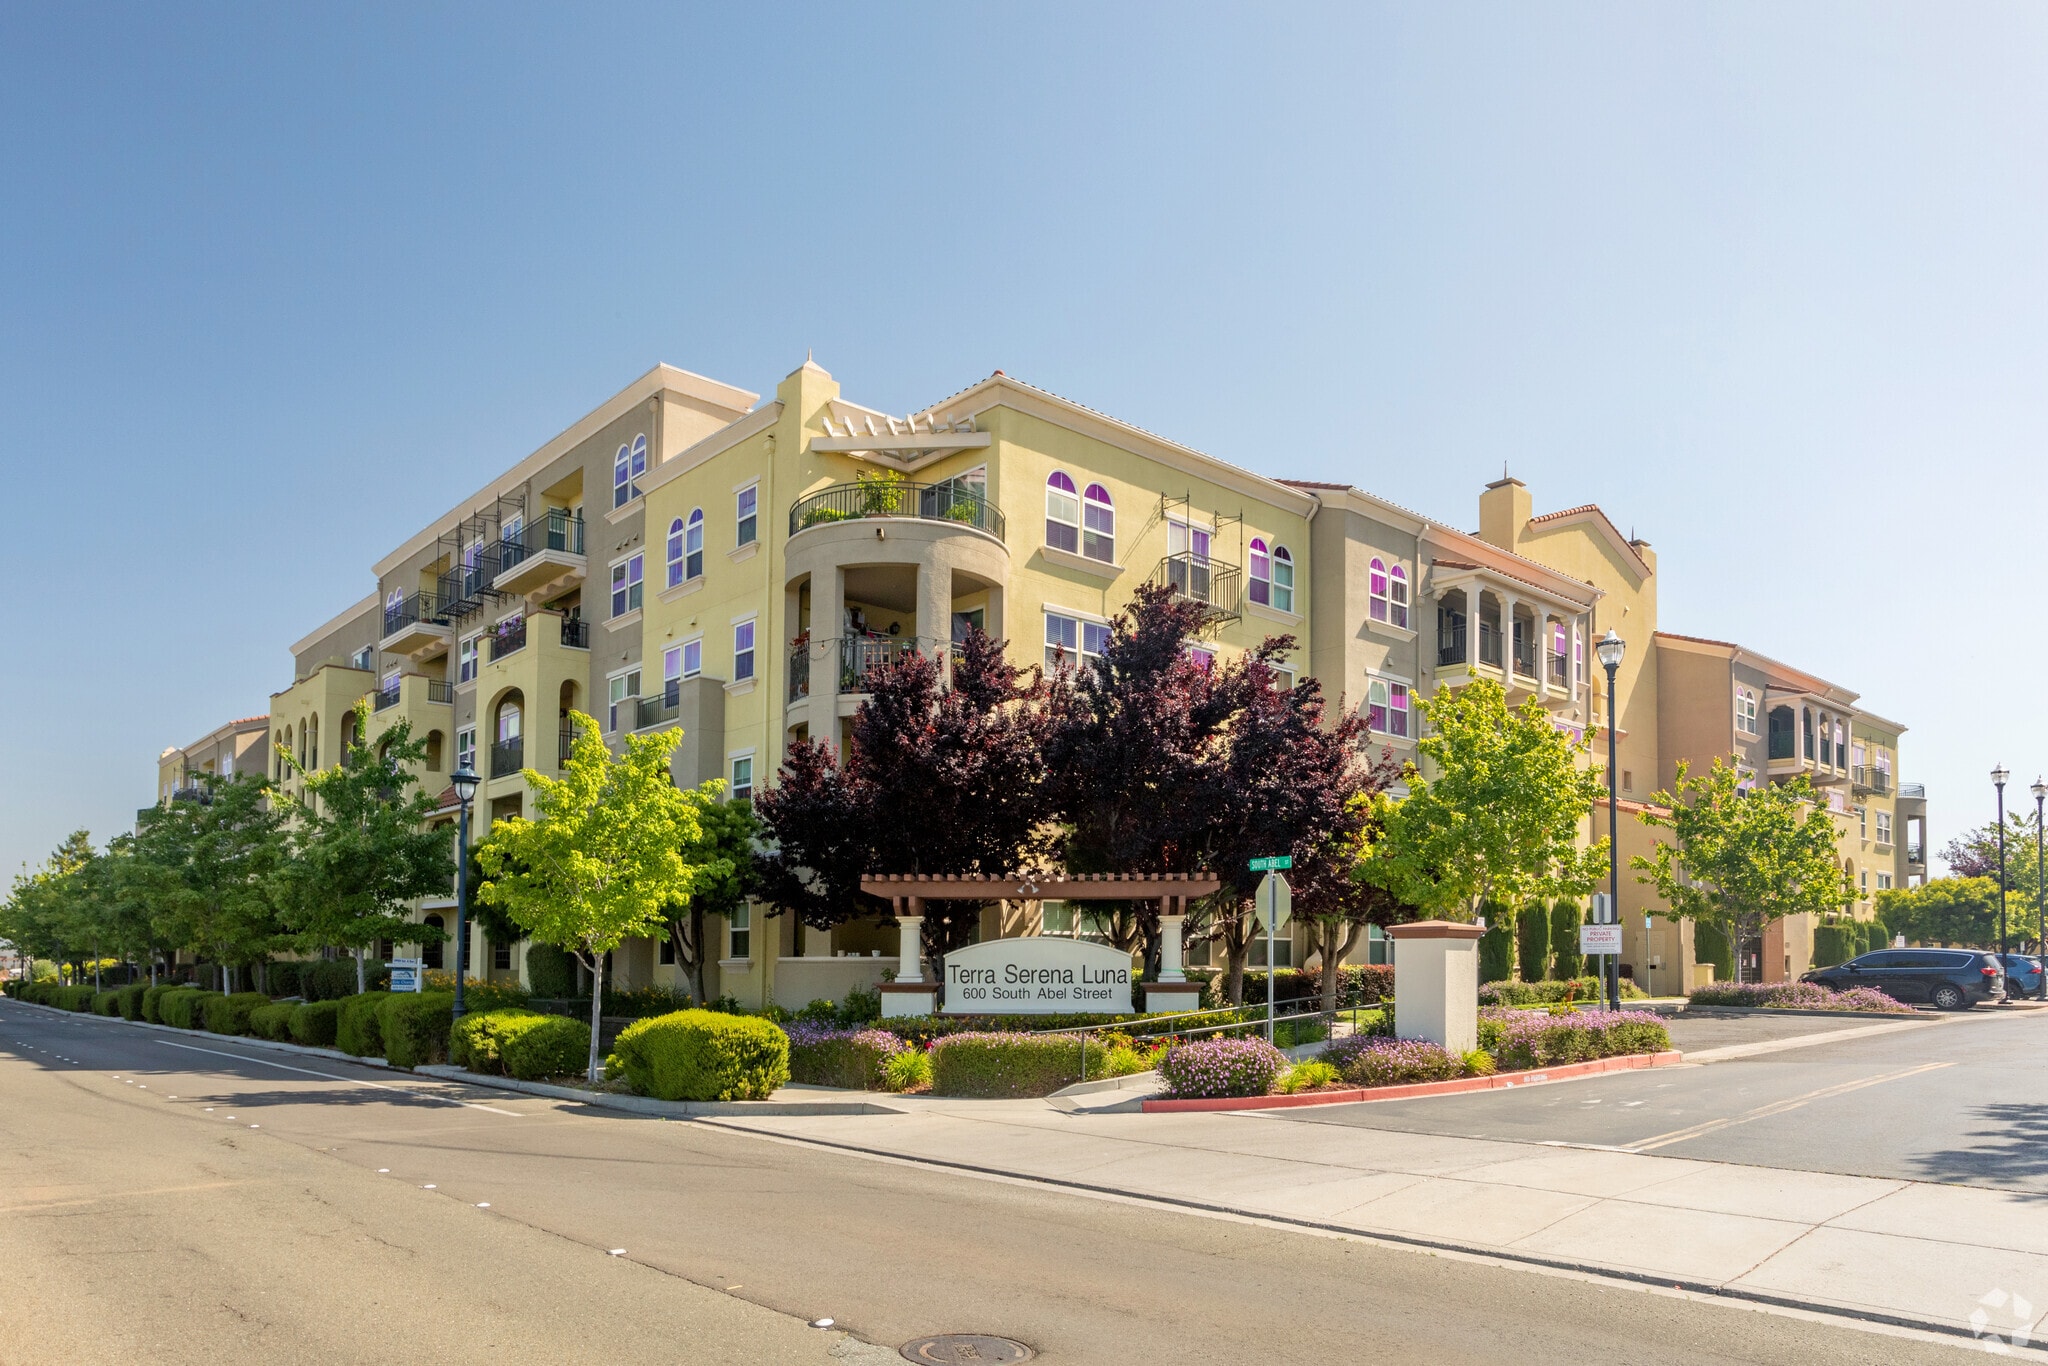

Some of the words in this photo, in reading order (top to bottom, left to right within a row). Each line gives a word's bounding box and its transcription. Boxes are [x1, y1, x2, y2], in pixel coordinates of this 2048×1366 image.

[1251, 860, 1267, 870] SOUTH
[1267, 859, 1281, 868] ABEL
[948, 964, 996, 984] Terra
[1004, 964, 1074, 984] Serena
[1082, 964, 1128, 984] Luna
[963, 987, 987, 1000] 600
[992, 987, 1031, 1000] South
[1037, 987, 1067, 1000] Abel
[1072, 987, 1113, 1000] Street
